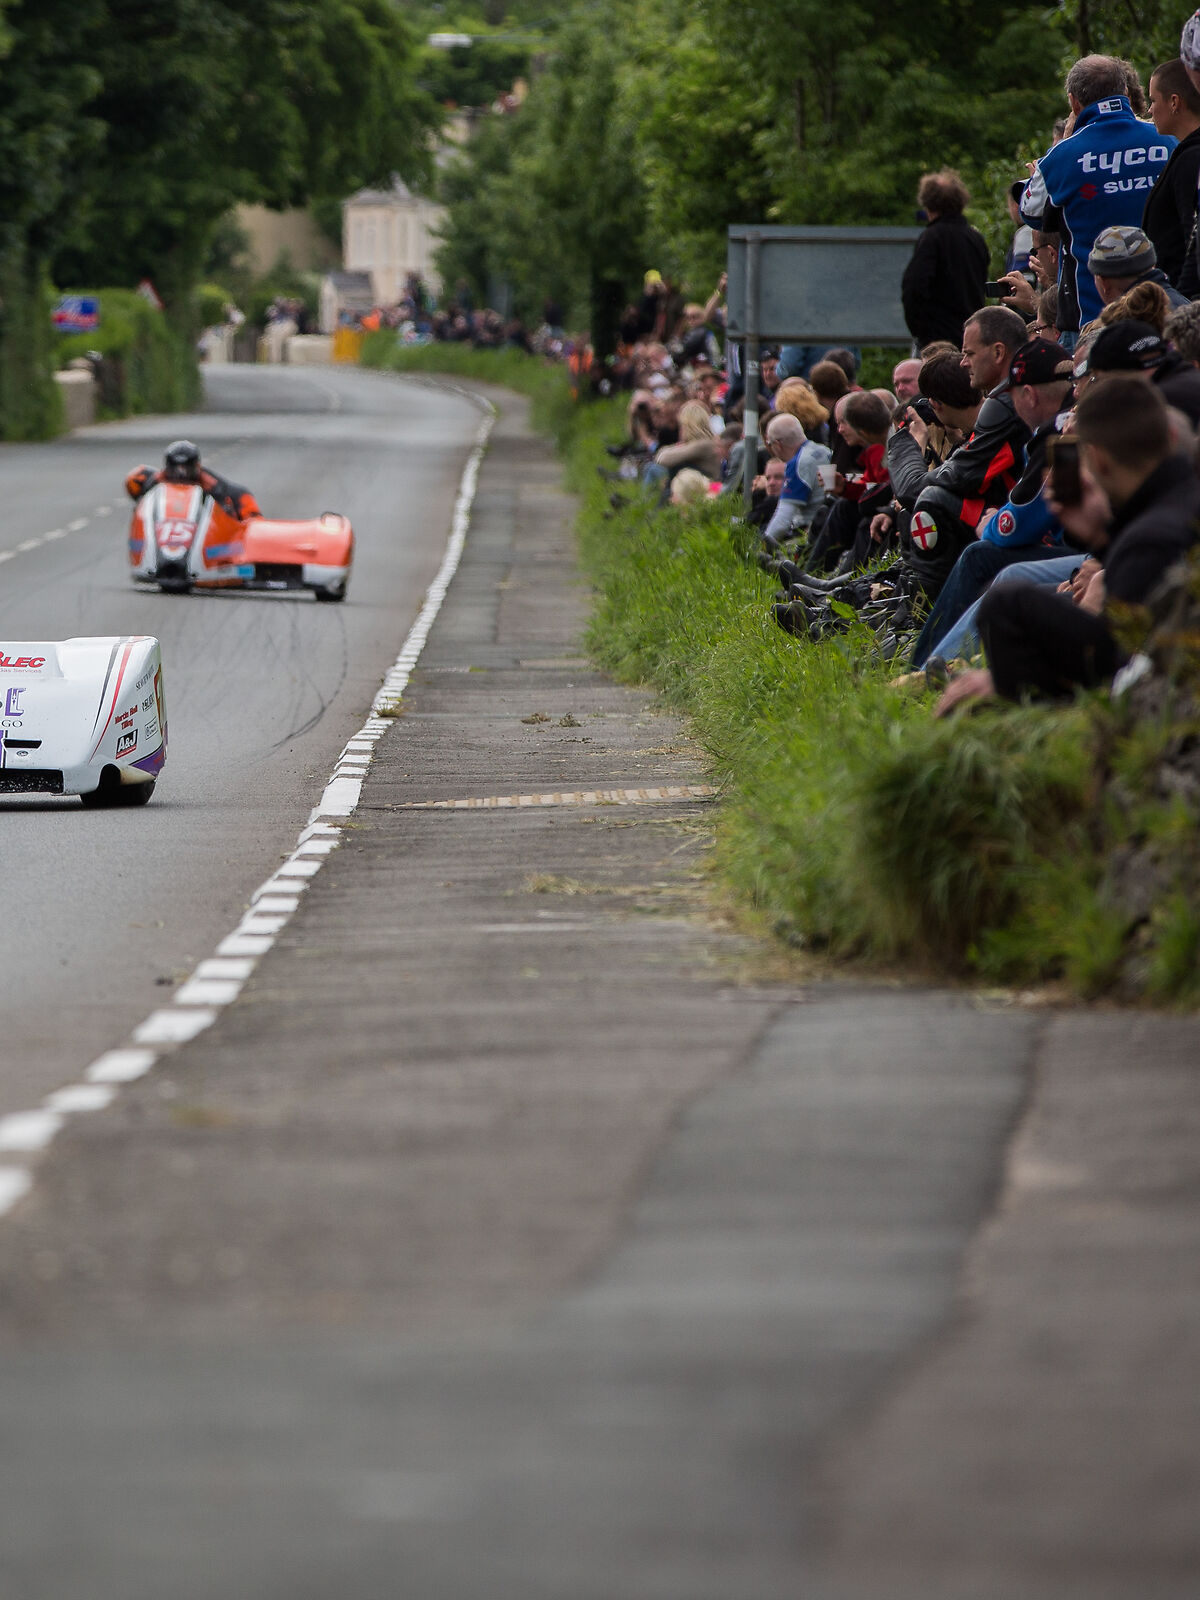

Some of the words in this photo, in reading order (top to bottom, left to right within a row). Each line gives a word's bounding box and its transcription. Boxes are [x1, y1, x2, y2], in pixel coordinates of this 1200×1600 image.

[1077, 146, 1168, 174] tyco
[158, 521, 194, 541] 15
[117, 730, 137, 752] A&J
